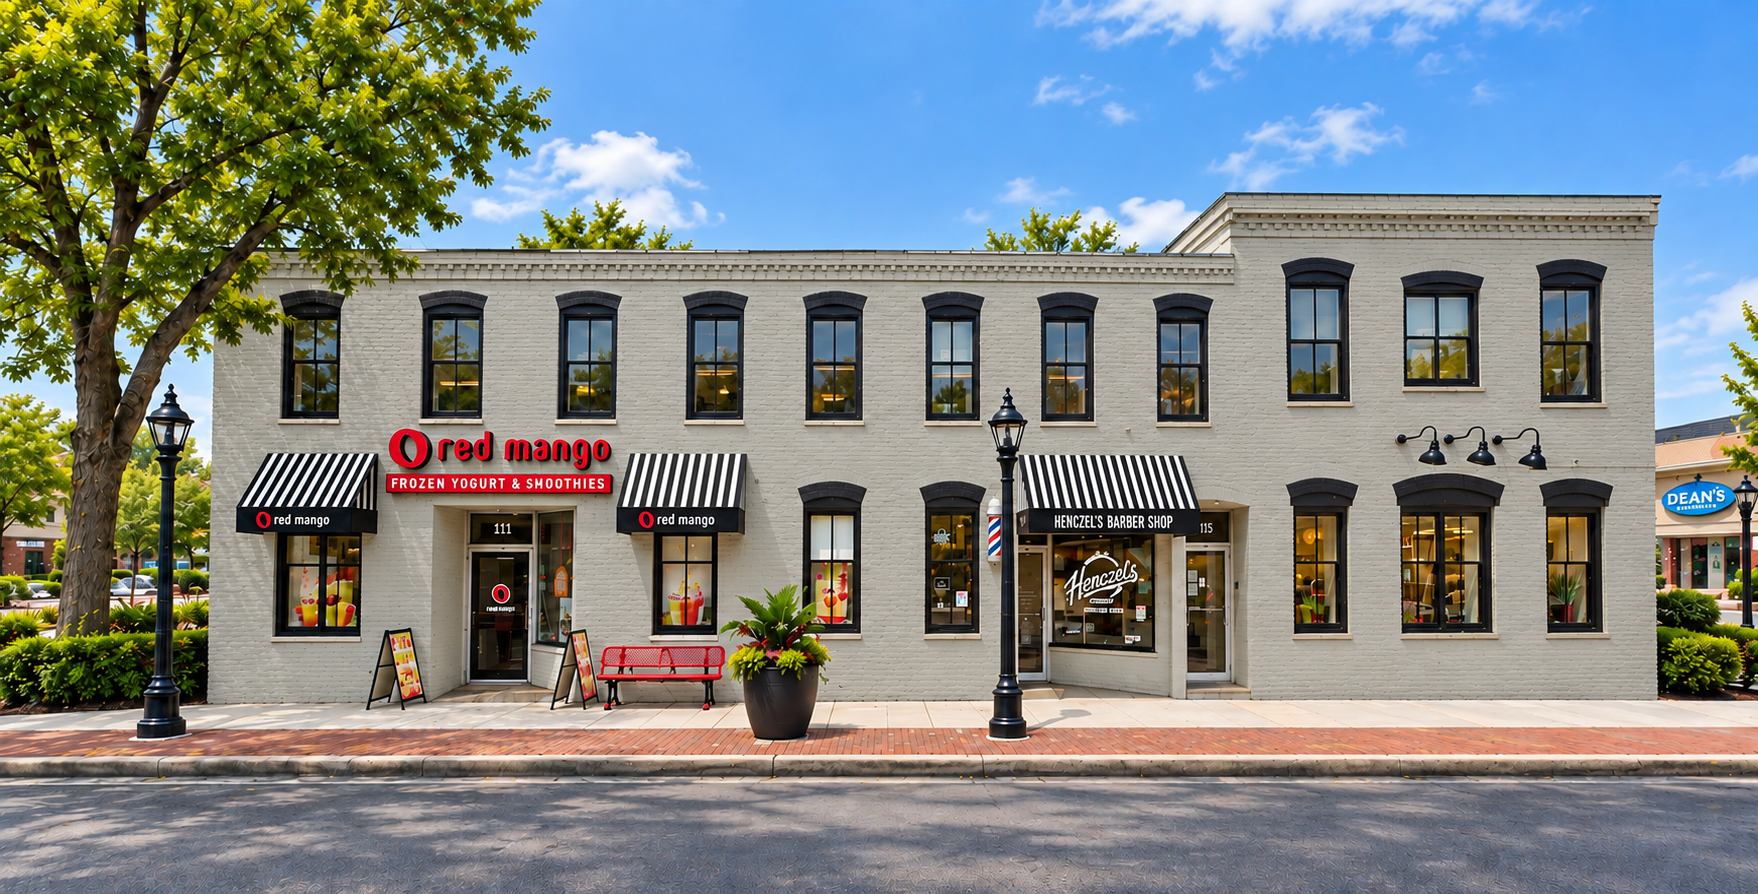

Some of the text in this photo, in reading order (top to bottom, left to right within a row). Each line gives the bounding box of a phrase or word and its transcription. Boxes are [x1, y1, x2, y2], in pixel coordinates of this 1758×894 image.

[437, 430, 612, 470] red mango
[391, 477, 605, 489] FROZEN YOGURT & SMOOTHIES
[1667, 488, 1726, 506] DEAN'S
[273, 513, 330, 528] red mango
[656, 513, 715, 528] red mango
[1054, 514, 1174, 529] HENCZEL'S BARBER SHOP
[1200, 522, 1214, 534] 115
[494, 522, 512, 535] 111
